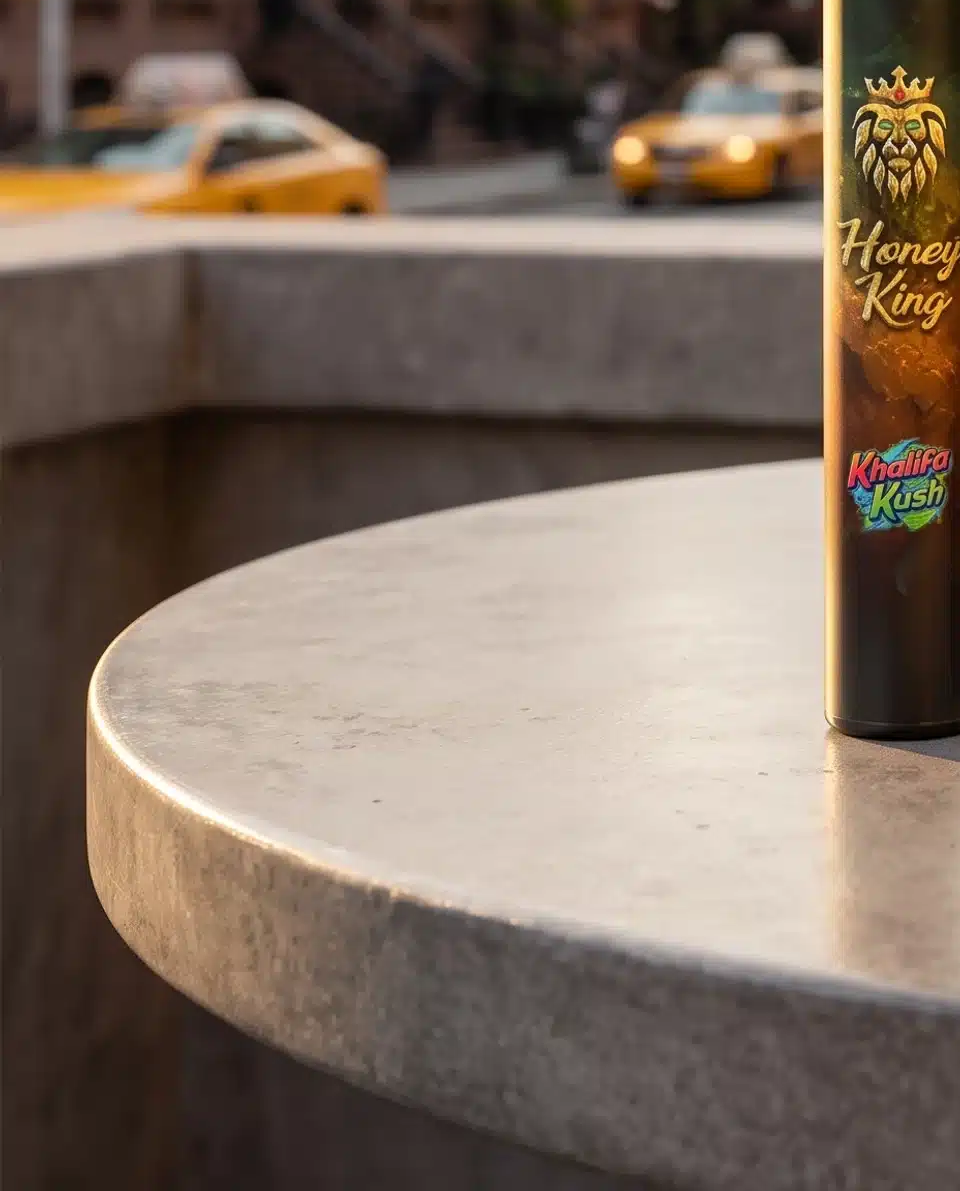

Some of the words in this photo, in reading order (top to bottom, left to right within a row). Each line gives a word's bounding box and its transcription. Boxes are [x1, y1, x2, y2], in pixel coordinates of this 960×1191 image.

[854, 268, 953, 330] King
[847, 448, 952, 489] Khalifa
[869, 478, 946, 523] Kush
